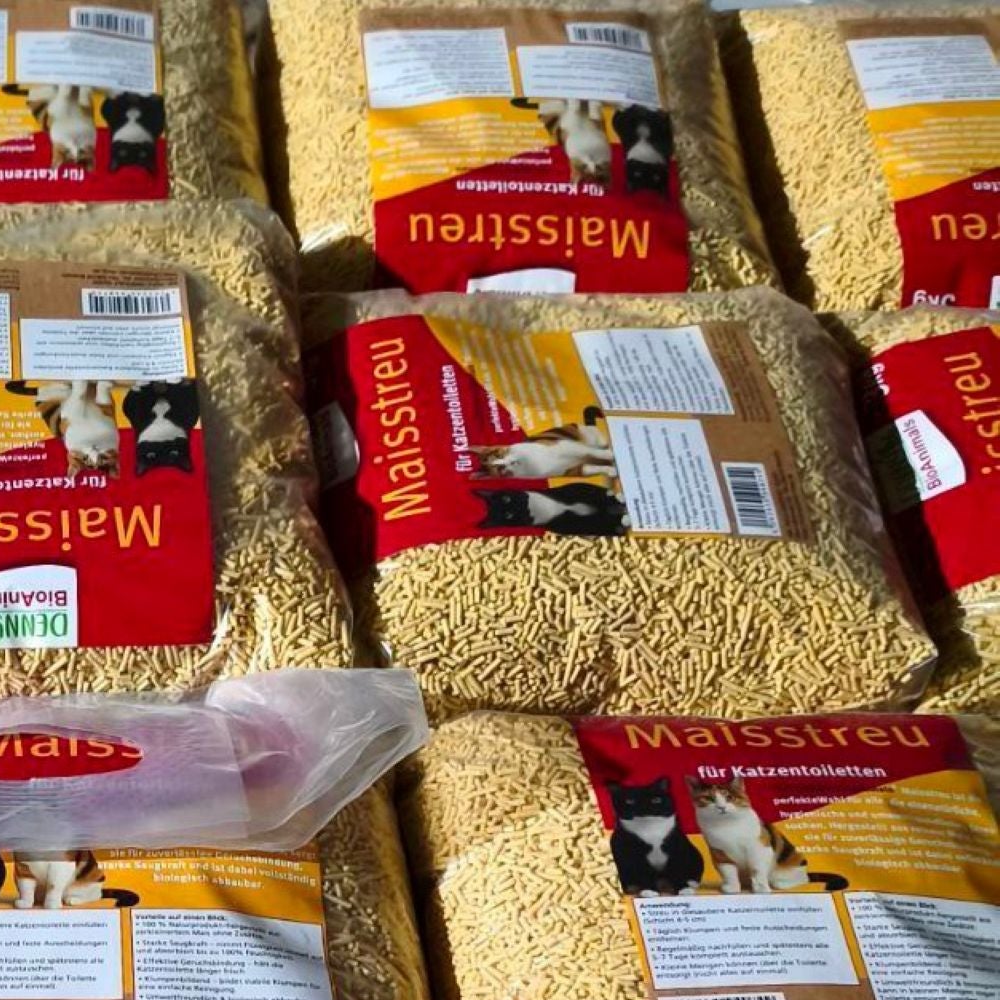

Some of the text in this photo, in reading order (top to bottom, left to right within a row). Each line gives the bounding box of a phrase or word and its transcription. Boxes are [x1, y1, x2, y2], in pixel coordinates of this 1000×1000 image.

[62, 168, 84, 180] für
[456, 179, 604, 197] für Katzentoiletten
[409, 212, 650, 258] Maisstreu
[370, 337, 432, 522] Maisstreu
[441, 364, 474, 472] für Katzentoiletten
[902, 418, 942, 491] BioAnimals
[81, 475, 107, 488] für
[625, 722, 931, 749] Maisstreu
[697, 764, 887, 779] für Katzentoiletten
